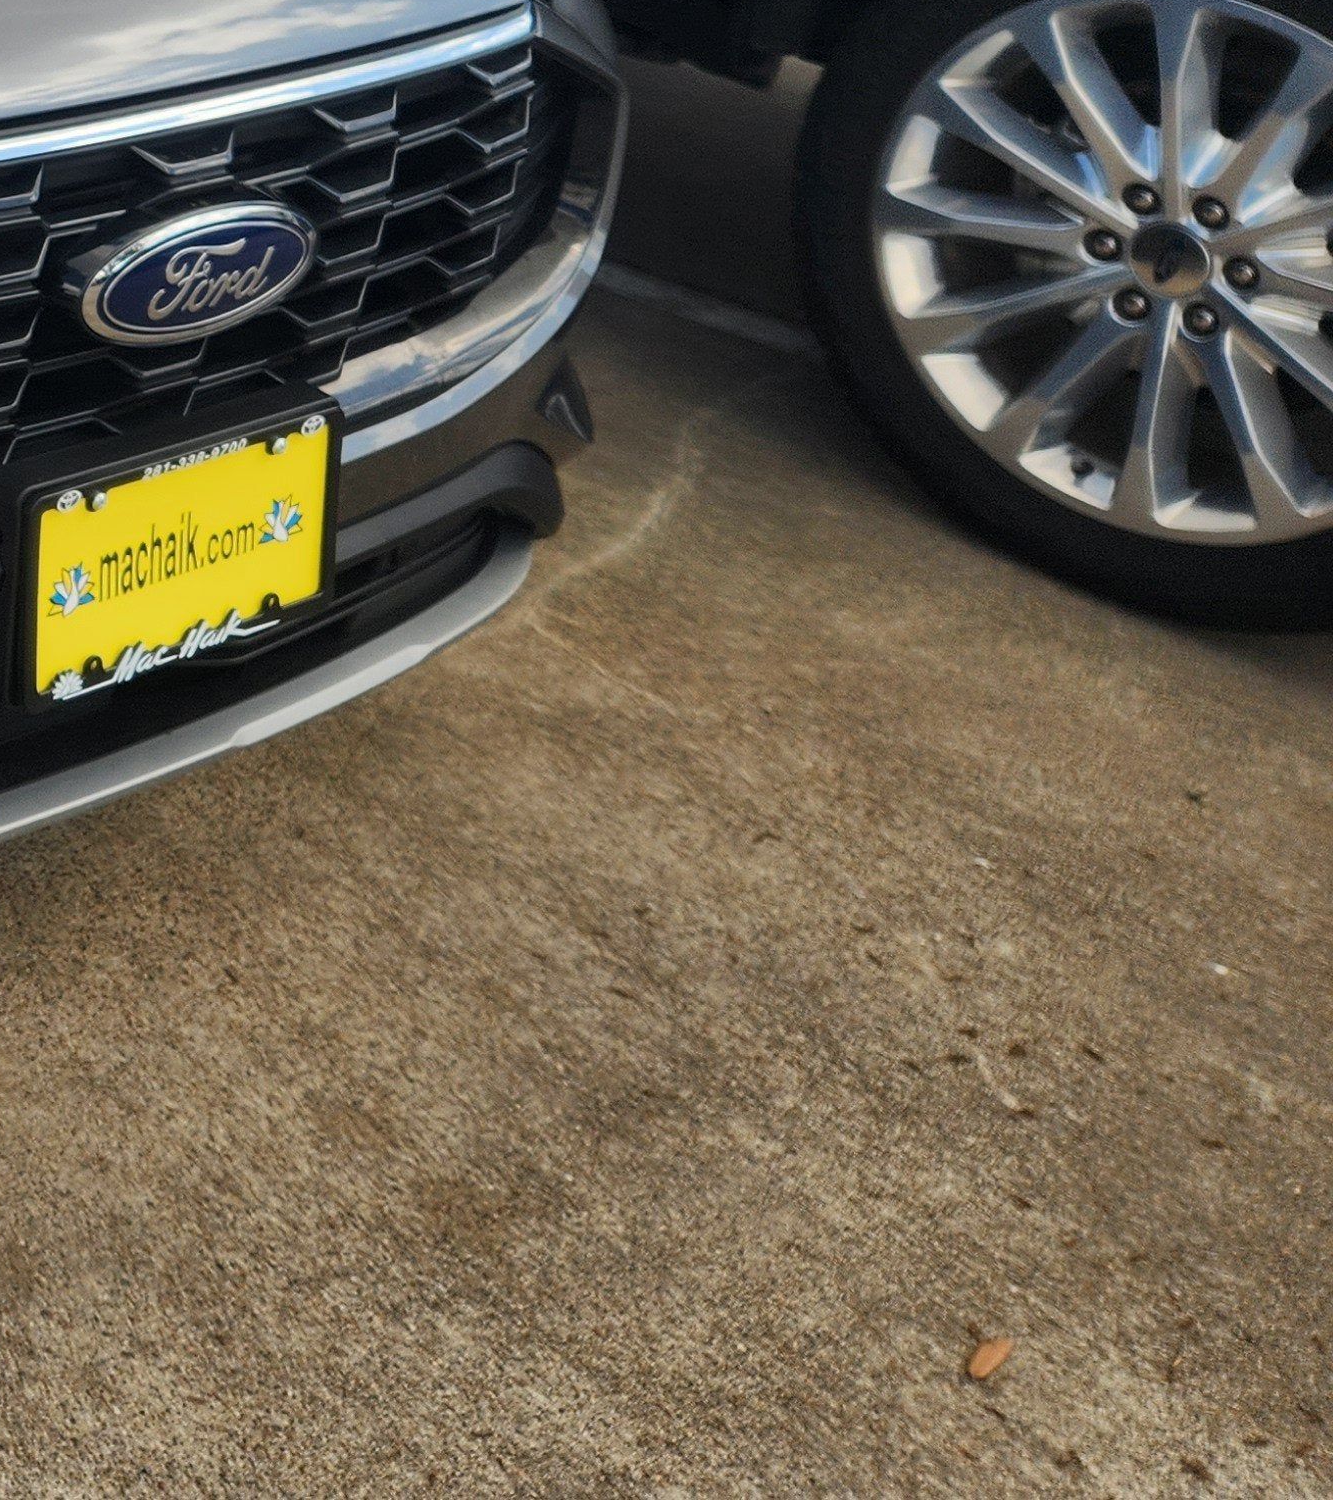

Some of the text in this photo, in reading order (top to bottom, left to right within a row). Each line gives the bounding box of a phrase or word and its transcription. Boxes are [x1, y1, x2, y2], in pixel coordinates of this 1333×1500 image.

[147, 237, 276, 321] Ford
[98, 511, 255, 603] machaik.com
[112, 641, 178, 683] Mac
